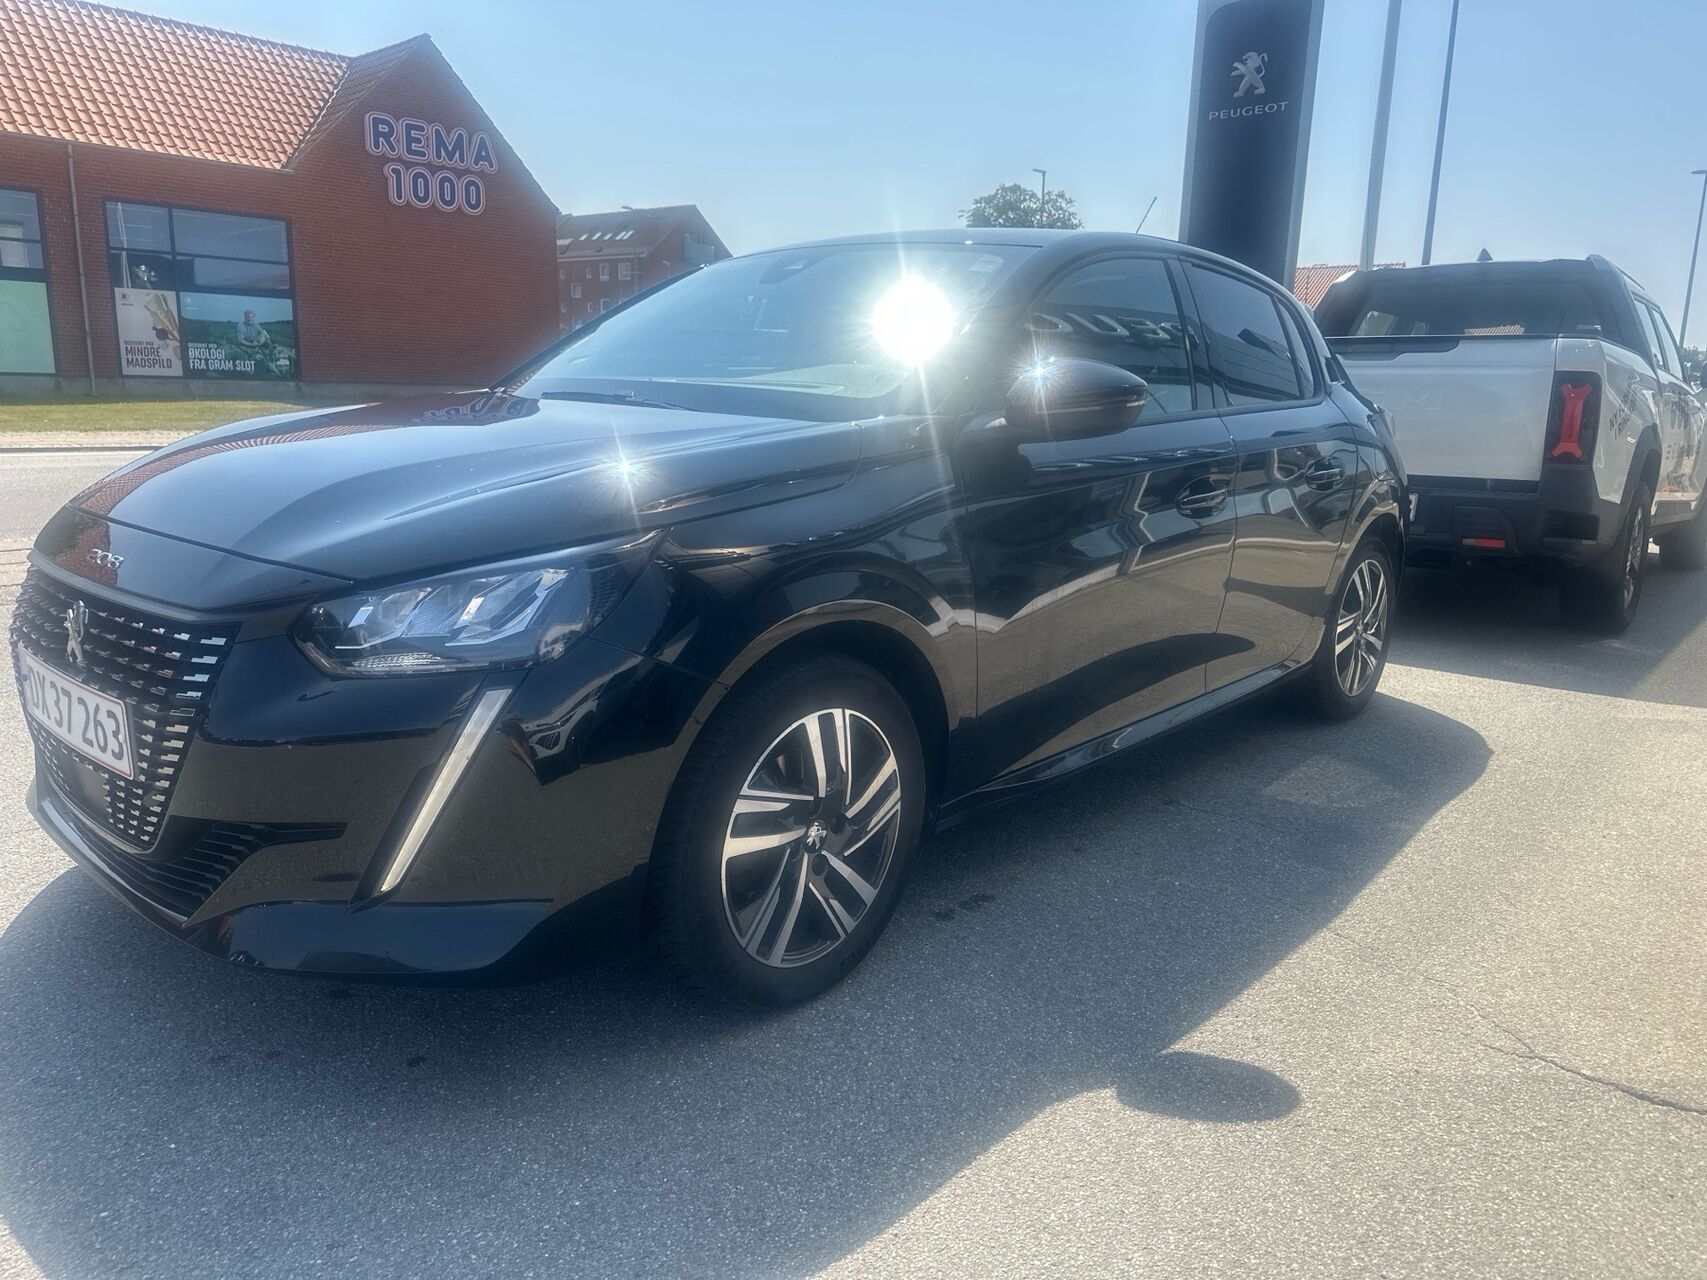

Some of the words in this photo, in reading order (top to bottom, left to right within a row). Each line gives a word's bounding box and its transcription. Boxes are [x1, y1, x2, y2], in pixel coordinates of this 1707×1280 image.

[1208, 101, 1289, 121] PEUGEOT
[365, 112, 498, 173] REMA
[383, 163, 485, 215] 1000
[125, 346, 161, 357] MINDRE
[188, 347, 225, 360] ØKOLOGI
[126, 357, 172, 369] MADSPILD
[189, 359, 207, 370] FRA
[208, 360, 233, 371] GRAM
[235, 360, 256, 372] SLOT
[27, 664, 51, 720] DX
[49, 680, 72, 735] 37
[77, 696, 124, 761] 263
